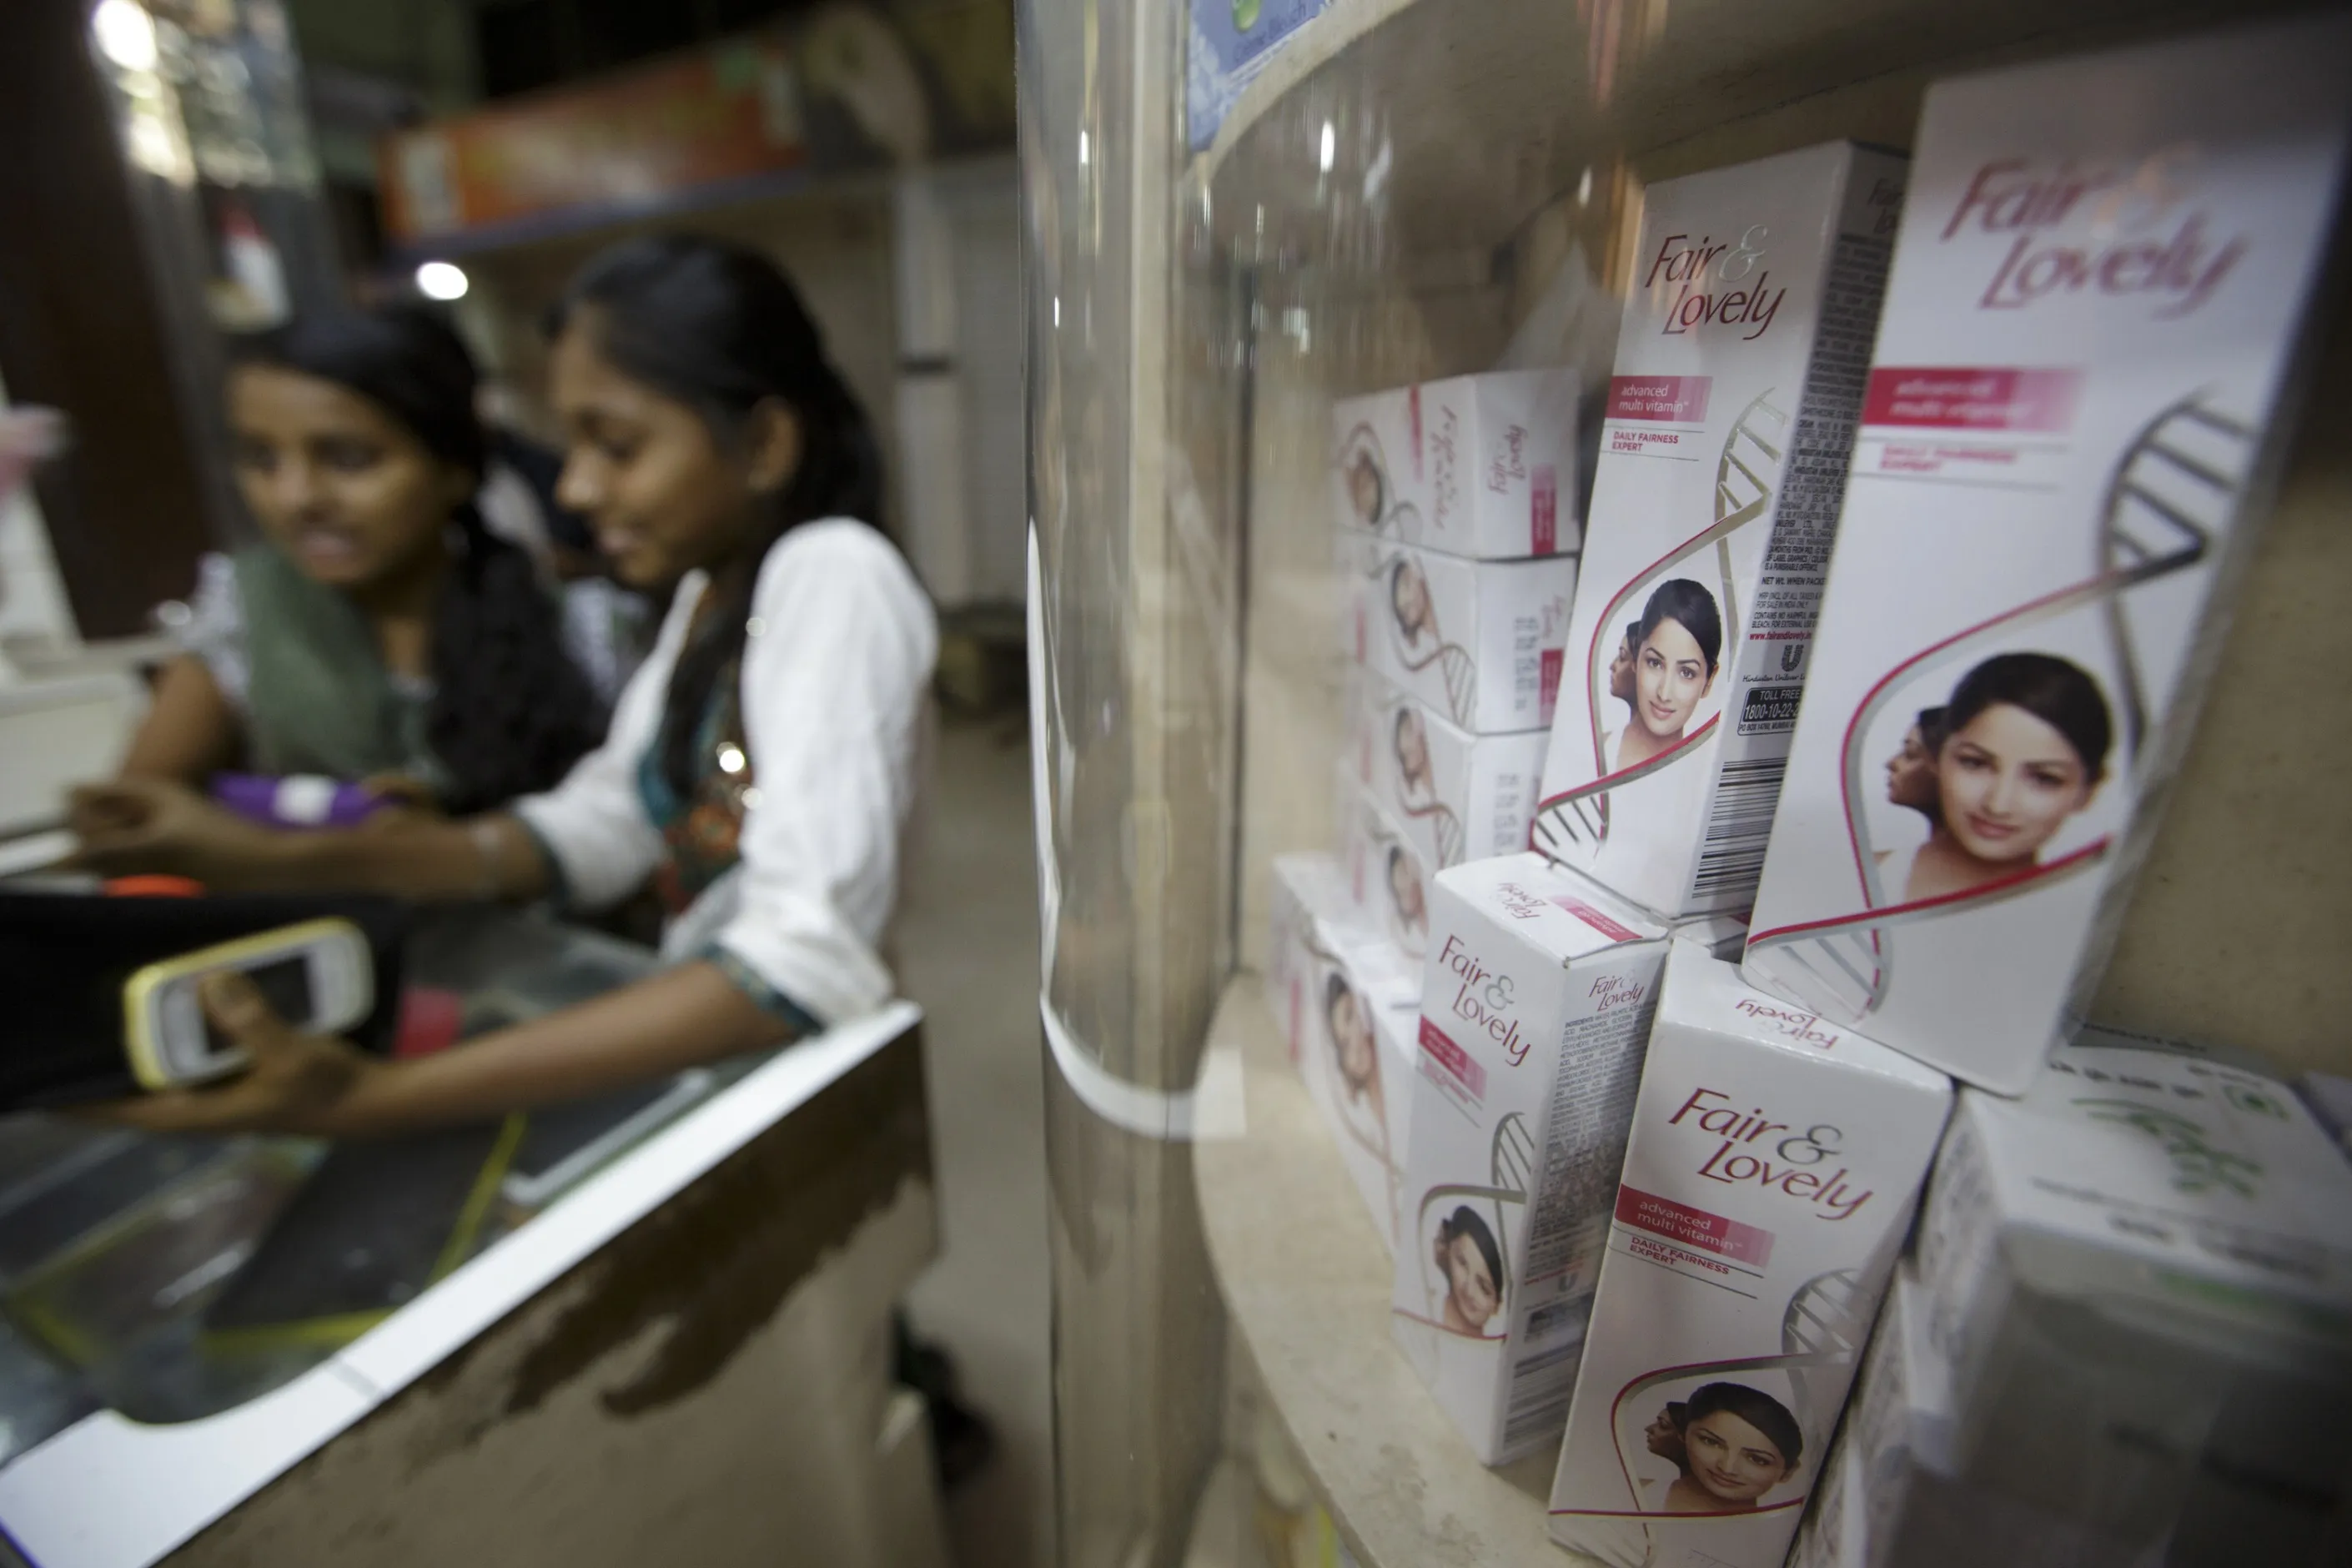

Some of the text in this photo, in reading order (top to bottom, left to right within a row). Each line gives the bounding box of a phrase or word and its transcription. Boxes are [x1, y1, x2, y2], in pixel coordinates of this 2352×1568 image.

[1939, 158, 2127, 243] Fair
[1646, 224, 1768, 289] Fair &
[1977, 209, 2250, 322] Lovely
[1661, 271, 1787, 340] Lovely
[1619, 399, 1643, 411] multi
[1621, 384, 1669, 397] advanced
[1612, 441, 1643, 452] EXPERT
[1613, 431, 1680, 445] DAILY FAIRNESS
[1806, 576, 1827, 585] PACKE
[1760, 689, 1801, 701] TOLL FREE
[1745, 701, 1802, 720] 1800-10-22-2
[1439, 934, 1515, 1010] Fair &
[1588, 975, 1622, 998] Fair
[1597, 983, 1645, 1012] Lovely
[1451, 983, 1531, 1067] Lovely
[1735, 999, 1817, 1028] Lovely
[1780, 1028, 1839, 1049] Fair
[1668, 1087, 1788, 1143] Fair
[1776, 1123, 1842, 1166] &
[1696, 1139, 1875, 1221] Lovely
[1637, 1212, 1675, 1232] multi
[1639, 1201, 1712, 1231] advanced
[1629, 1244, 1678, 1265] EXPERT
[1631, 1236, 1731, 1275] DAILY FAIRNESS
